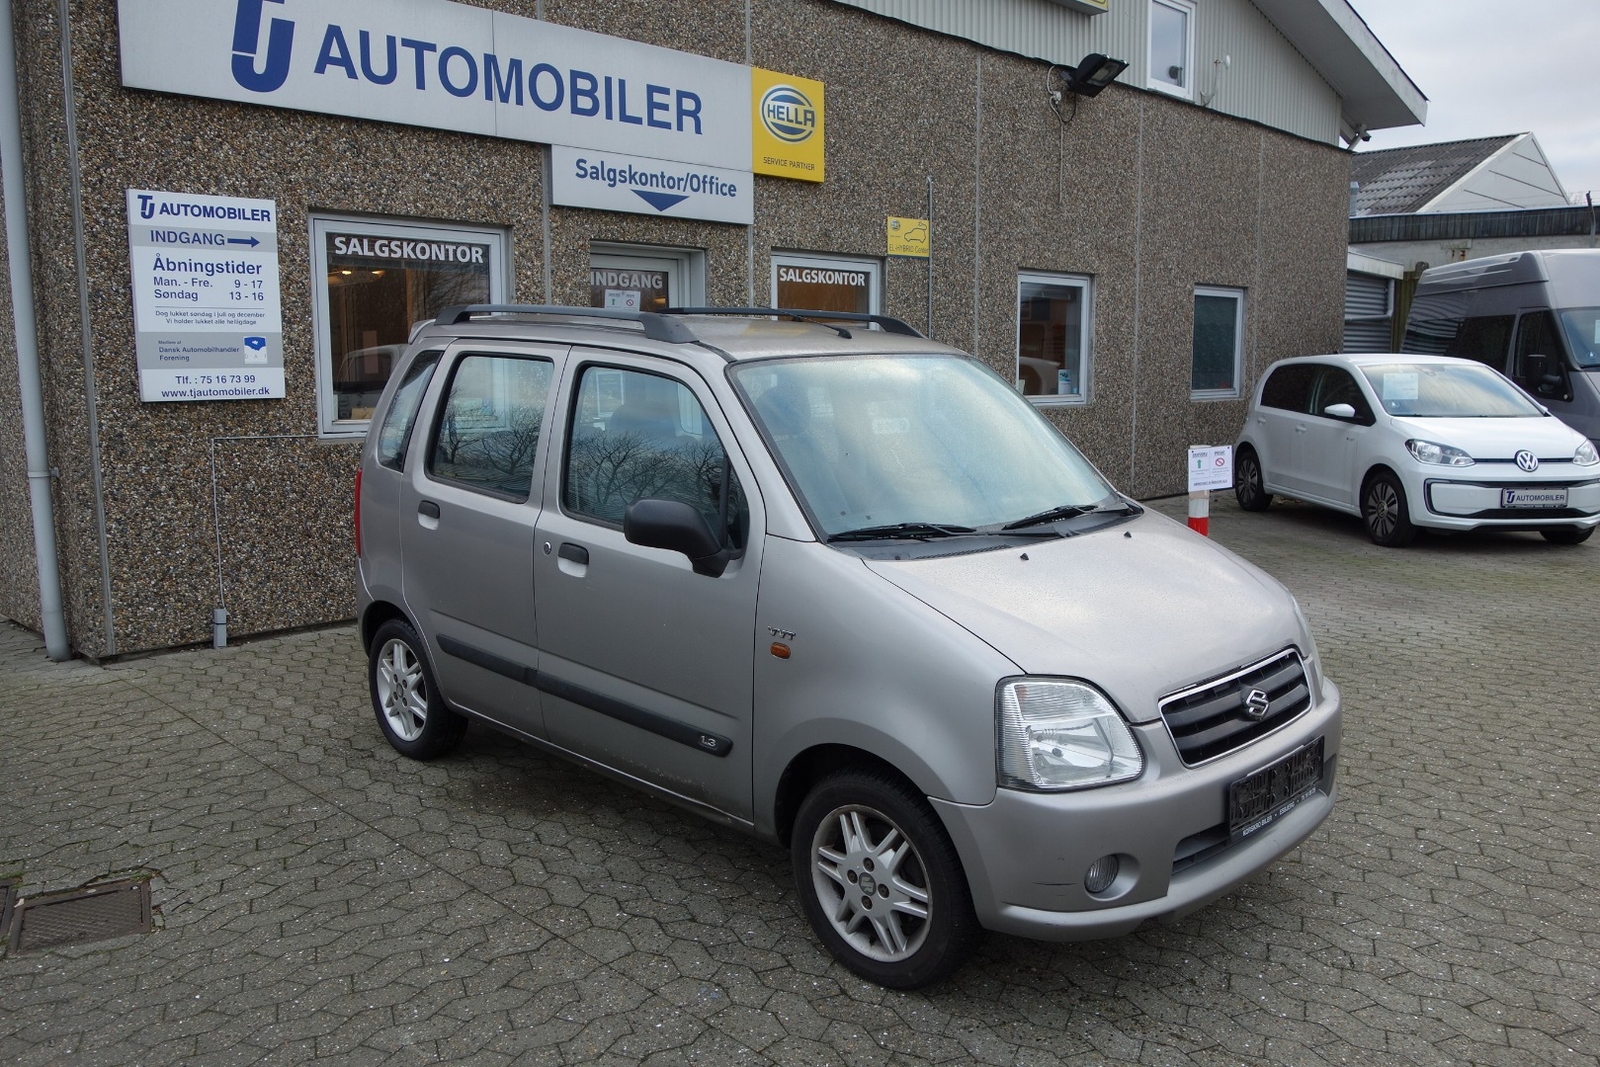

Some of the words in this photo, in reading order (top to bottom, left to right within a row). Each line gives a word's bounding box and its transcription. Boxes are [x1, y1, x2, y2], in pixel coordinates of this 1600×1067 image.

[314, 23, 703, 135] AUTOMOBILER
[767, 103, 816, 128] HELLA
[763, 156, 788, 167] SERVICE
[789, 160, 816, 171] PARTNER
[575, 158, 737, 197] Salgskontor/Office
[137, 194, 156, 219] TJ
[159, 202, 271, 222] AUTOMOBILER
[150, 229, 225, 246] INDGANG
[334, 236, 484, 264] SALGSKONTOR
[153, 252, 262, 277] Åbningstider
[153, 276, 181, 287] Man.
[191, 277, 213, 288] Fre.
[234, 279, 241, 289] 9
[251, 280, 263, 289] 17
[590, 271, 664, 290] INDGANG
[780, 267, 866, 287] SALGSKONTOR
[154, 288, 199, 302] Søndag
[229, 291, 242, 301] 13
[252, 291, 264, 301] 16
[155, 310, 168, 318] Dog
[175, 375, 192, 385] Tlf.
[200, 375, 213, 384] 75
[216, 375, 227, 384] 16
[230, 375, 241, 384] 73
[243, 374, 256, 383] 99
[161, 386, 270, 399] www.tjautomobiler.dk
[1516, 494, 1565, 502] AUTOMOBILER
